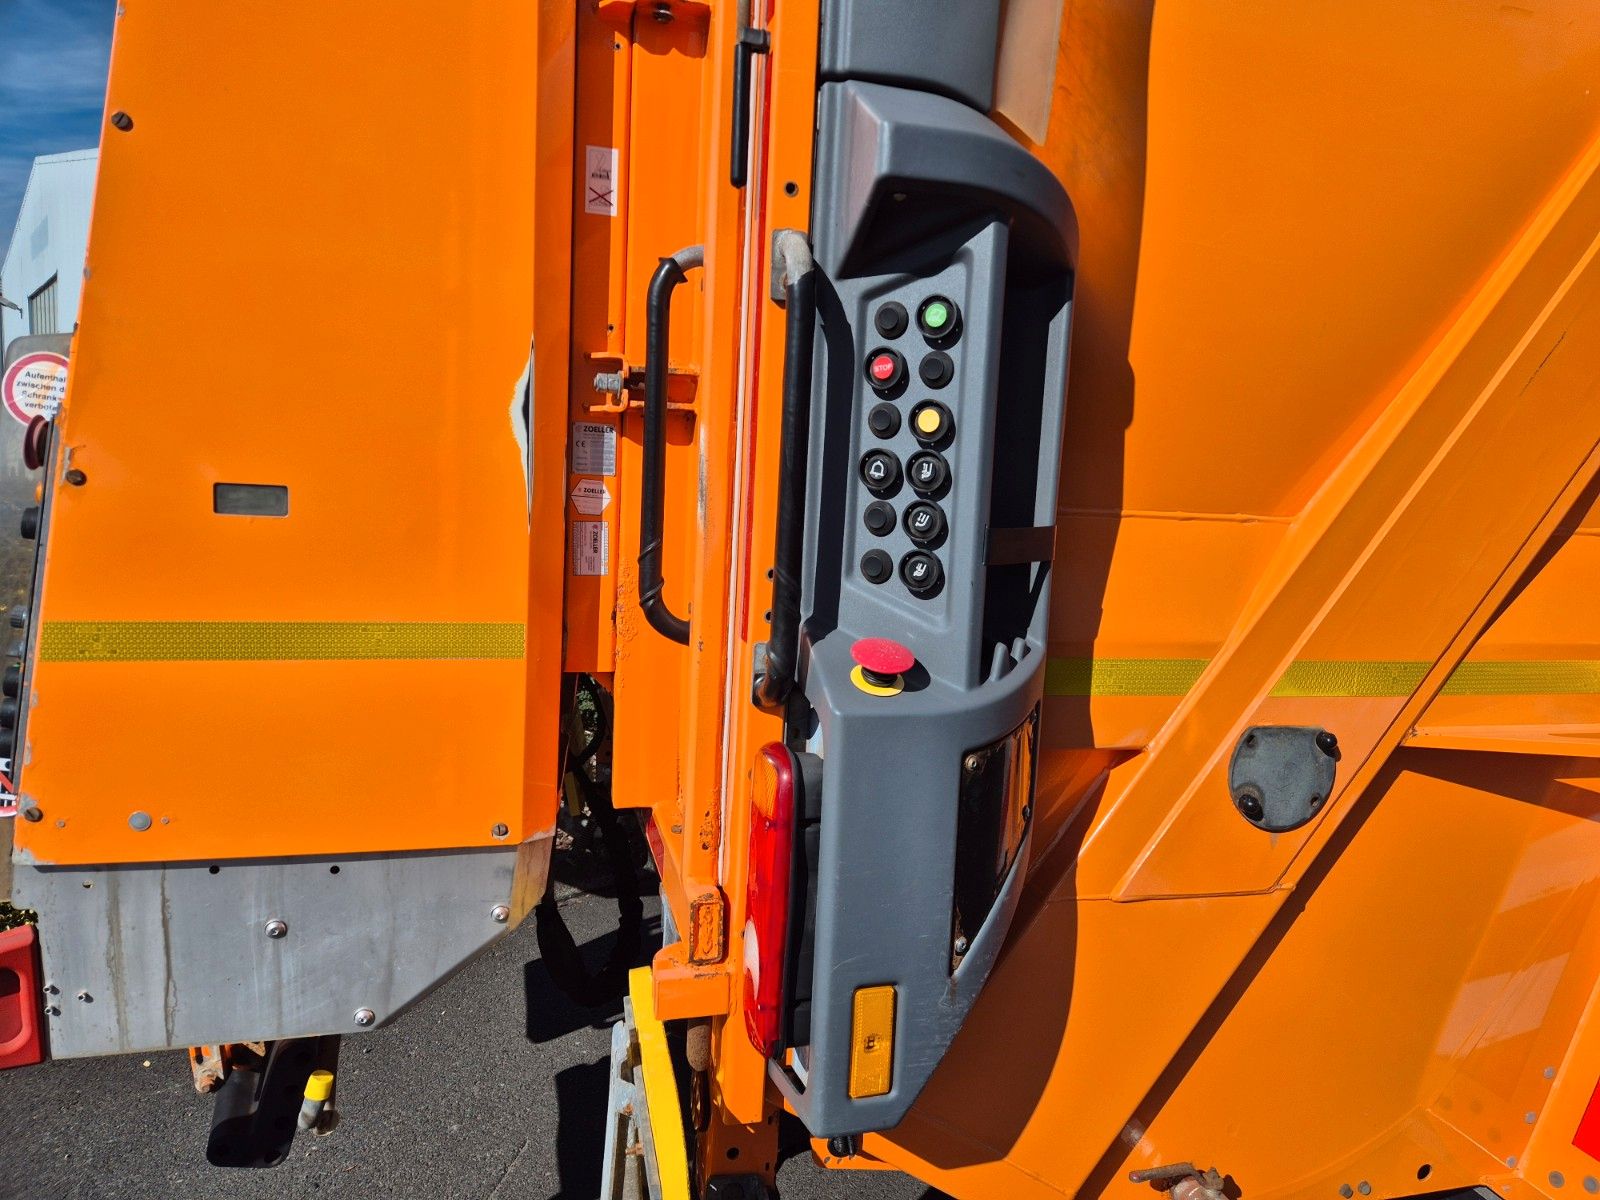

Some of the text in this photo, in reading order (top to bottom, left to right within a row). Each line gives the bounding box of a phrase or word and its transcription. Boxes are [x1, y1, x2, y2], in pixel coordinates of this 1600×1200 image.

[873, 363, 893, 373] STOP
[25, 371, 66, 382] Aufenthal
[17, 381, 57, 391] zwischen
[22, 390, 57, 401] Schrank
[25, 402, 59, 411] verbote
[583, 425, 614, 434] ZOELLER
[583, 487, 605, 495] ZOELLER
